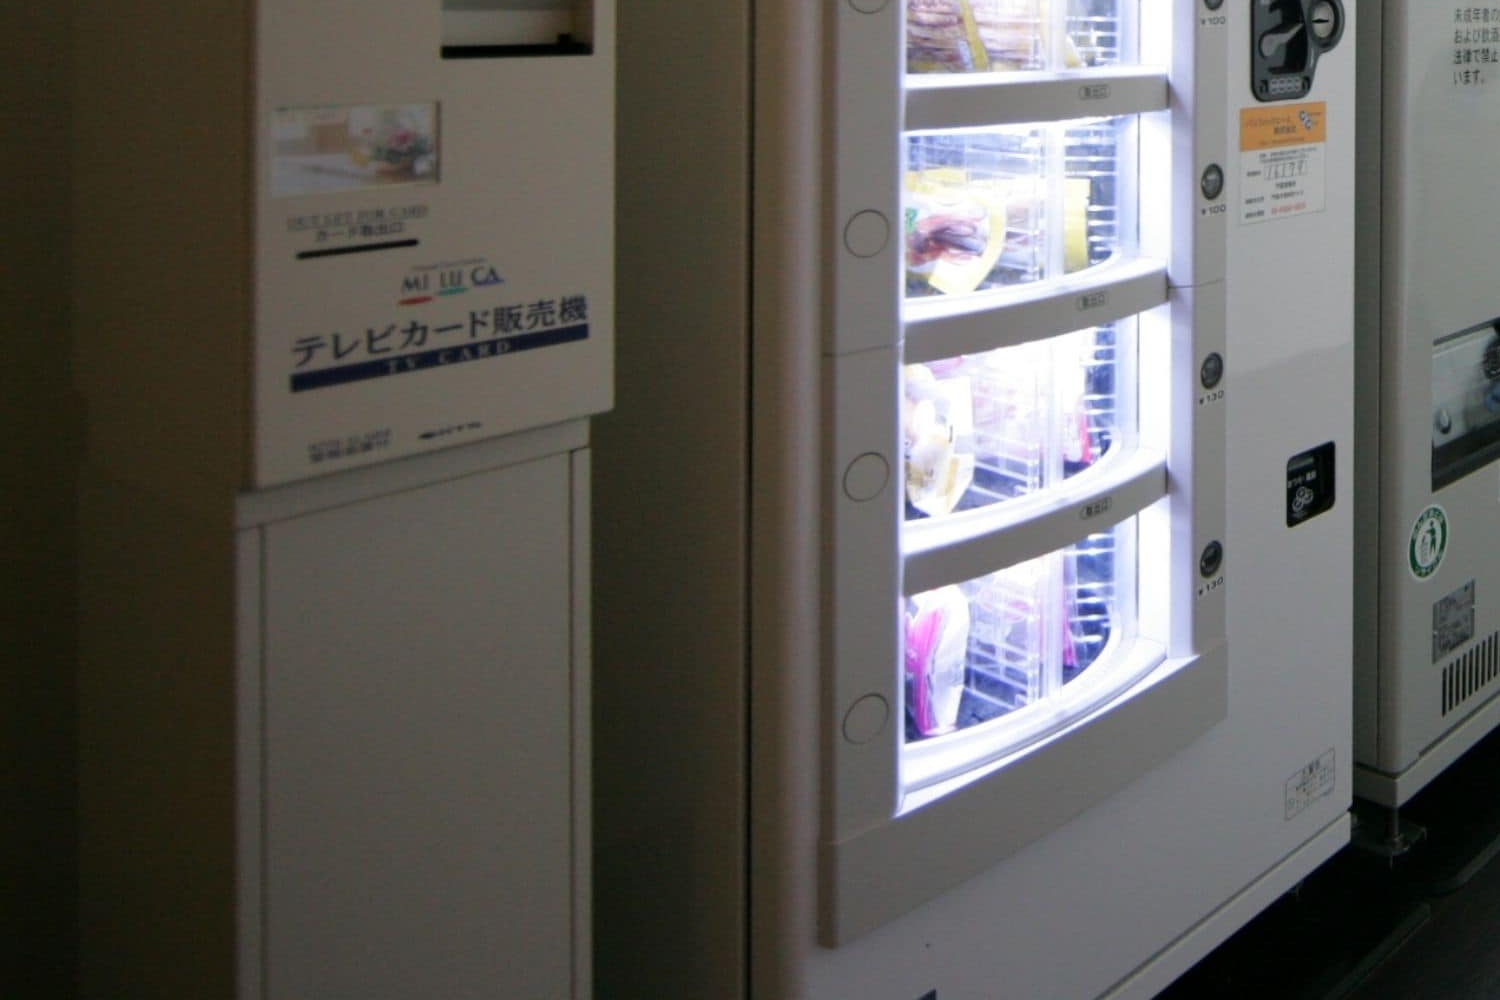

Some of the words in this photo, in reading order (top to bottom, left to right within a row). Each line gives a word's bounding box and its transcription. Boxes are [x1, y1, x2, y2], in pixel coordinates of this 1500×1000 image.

[292, 296, 588, 367] テレビカード販売機
[388, 356, 418, 374] TV
[437, 341, 512, 367] CARD
